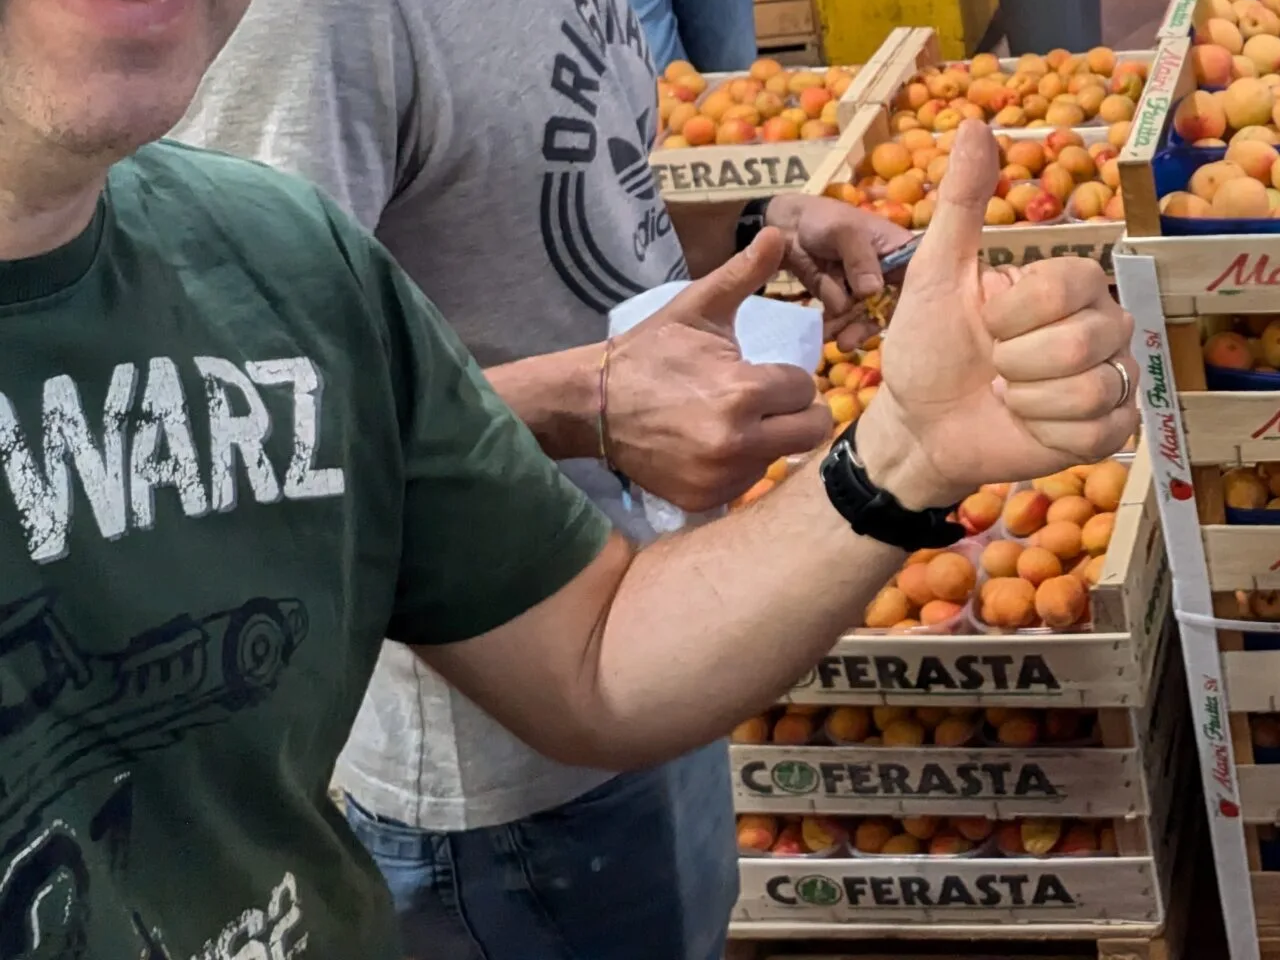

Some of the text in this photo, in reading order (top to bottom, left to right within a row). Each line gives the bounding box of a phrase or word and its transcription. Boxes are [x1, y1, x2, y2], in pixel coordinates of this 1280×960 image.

[652, 155, 811, 190] FERASTA
[1147, 352, 1169, 409] Frutta
[0, 357, 345, 562] WARZ
[1156, 413, 1184, 471] Maini
[794, 654, 1061, 691] FERASTA
